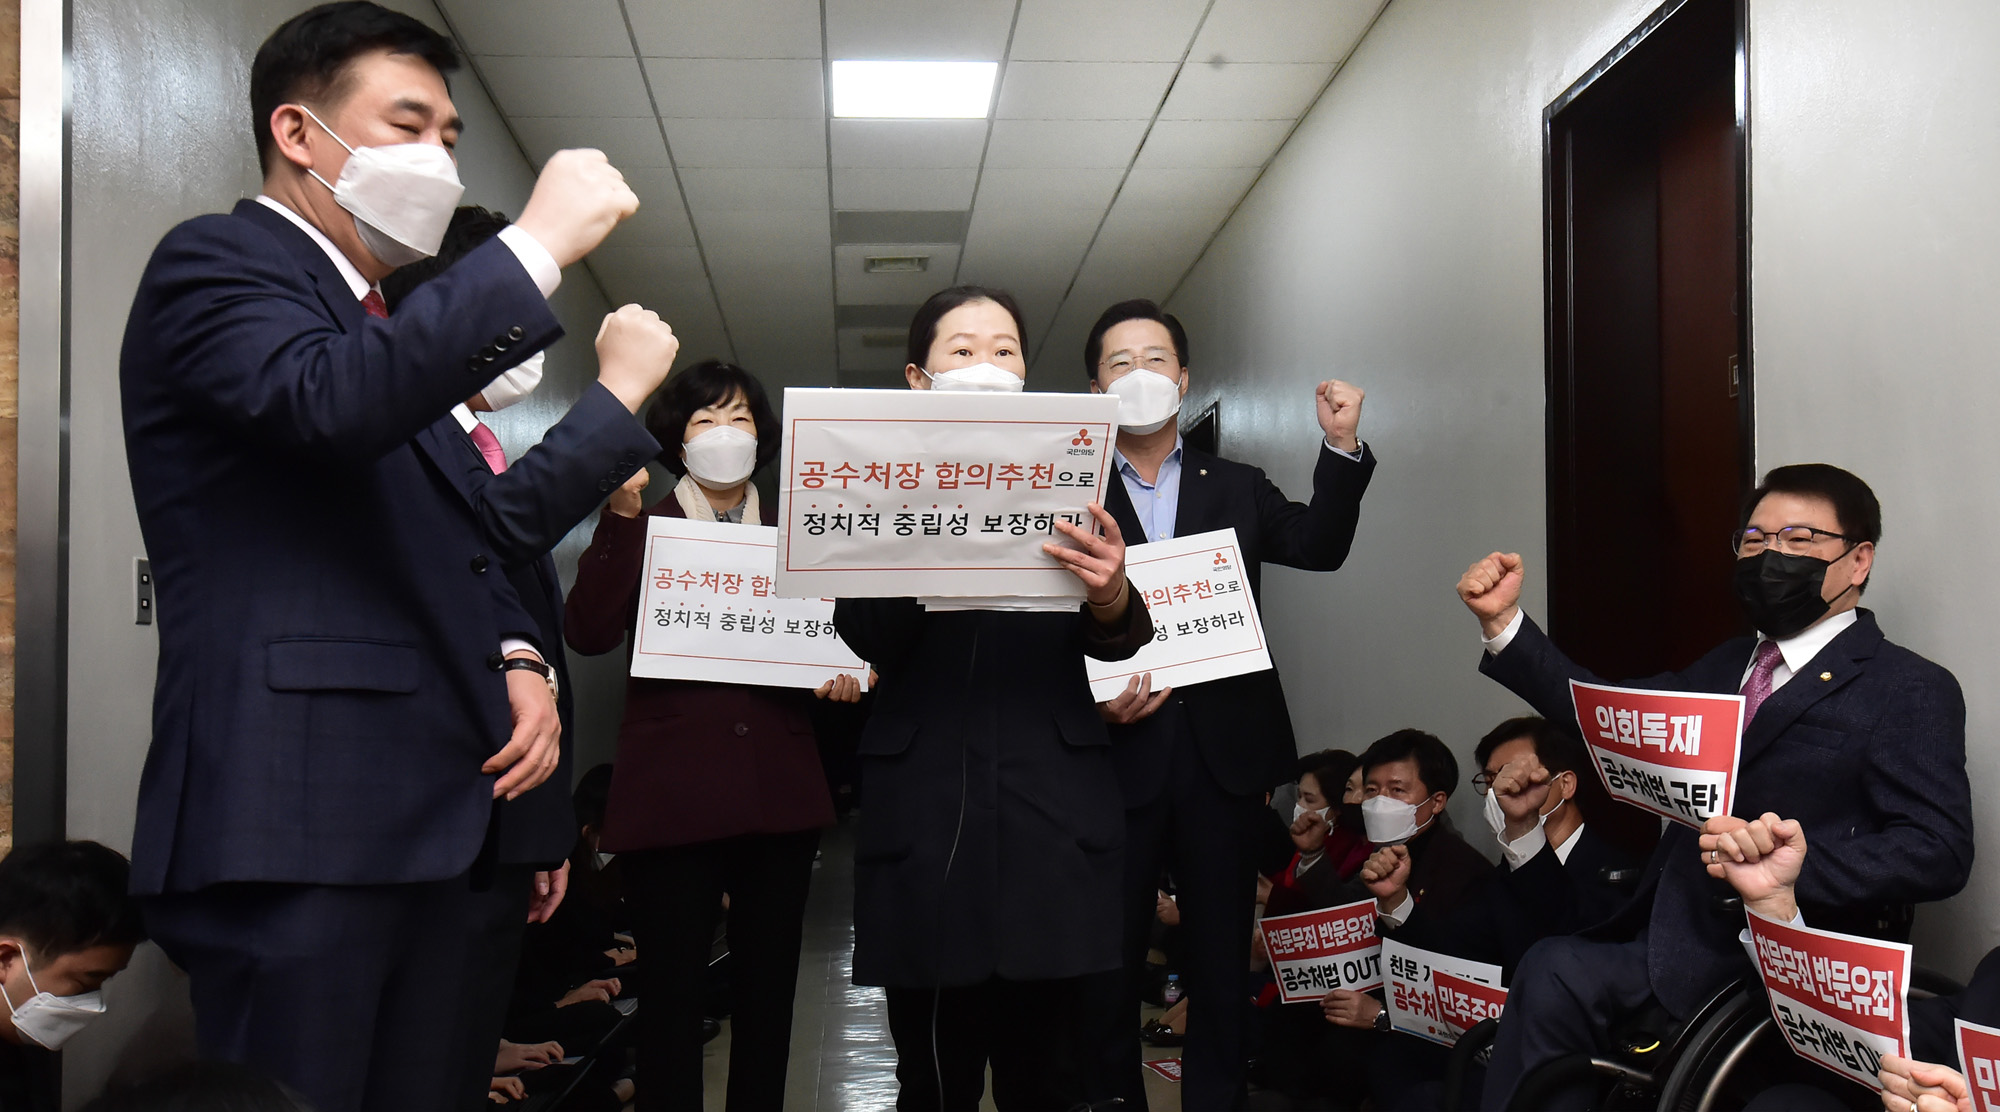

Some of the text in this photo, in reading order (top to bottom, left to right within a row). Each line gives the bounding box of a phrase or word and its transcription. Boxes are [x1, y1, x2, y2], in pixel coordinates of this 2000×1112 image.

[799, 461, 1095, 490] 공수처장 합의추천으로
[803, 512, 880, 536] 정치적
[893, 513, 969, 536] 중립성
[653, 568, 744, 595] 공수처장
[654, 608, 837, 639] 정치적 중립성 보장하
[1176, 611, 1245, 637] 보장하라
[1595, 705, 1703, 756] 의회독재
[1600, 756, 1718, 822] 공수처법 규탄
[1268, 912, 1376, 955] 친문무죄 반문유죄
[1281, 954, 1382, 992] 공수처법 OUT
[1389, 954, 1419, 983] 친문
[1755, 932, 1895, 1022] 친문무죄 반문유죄
[1776, 1003, 1863, 1072] 공수처법
